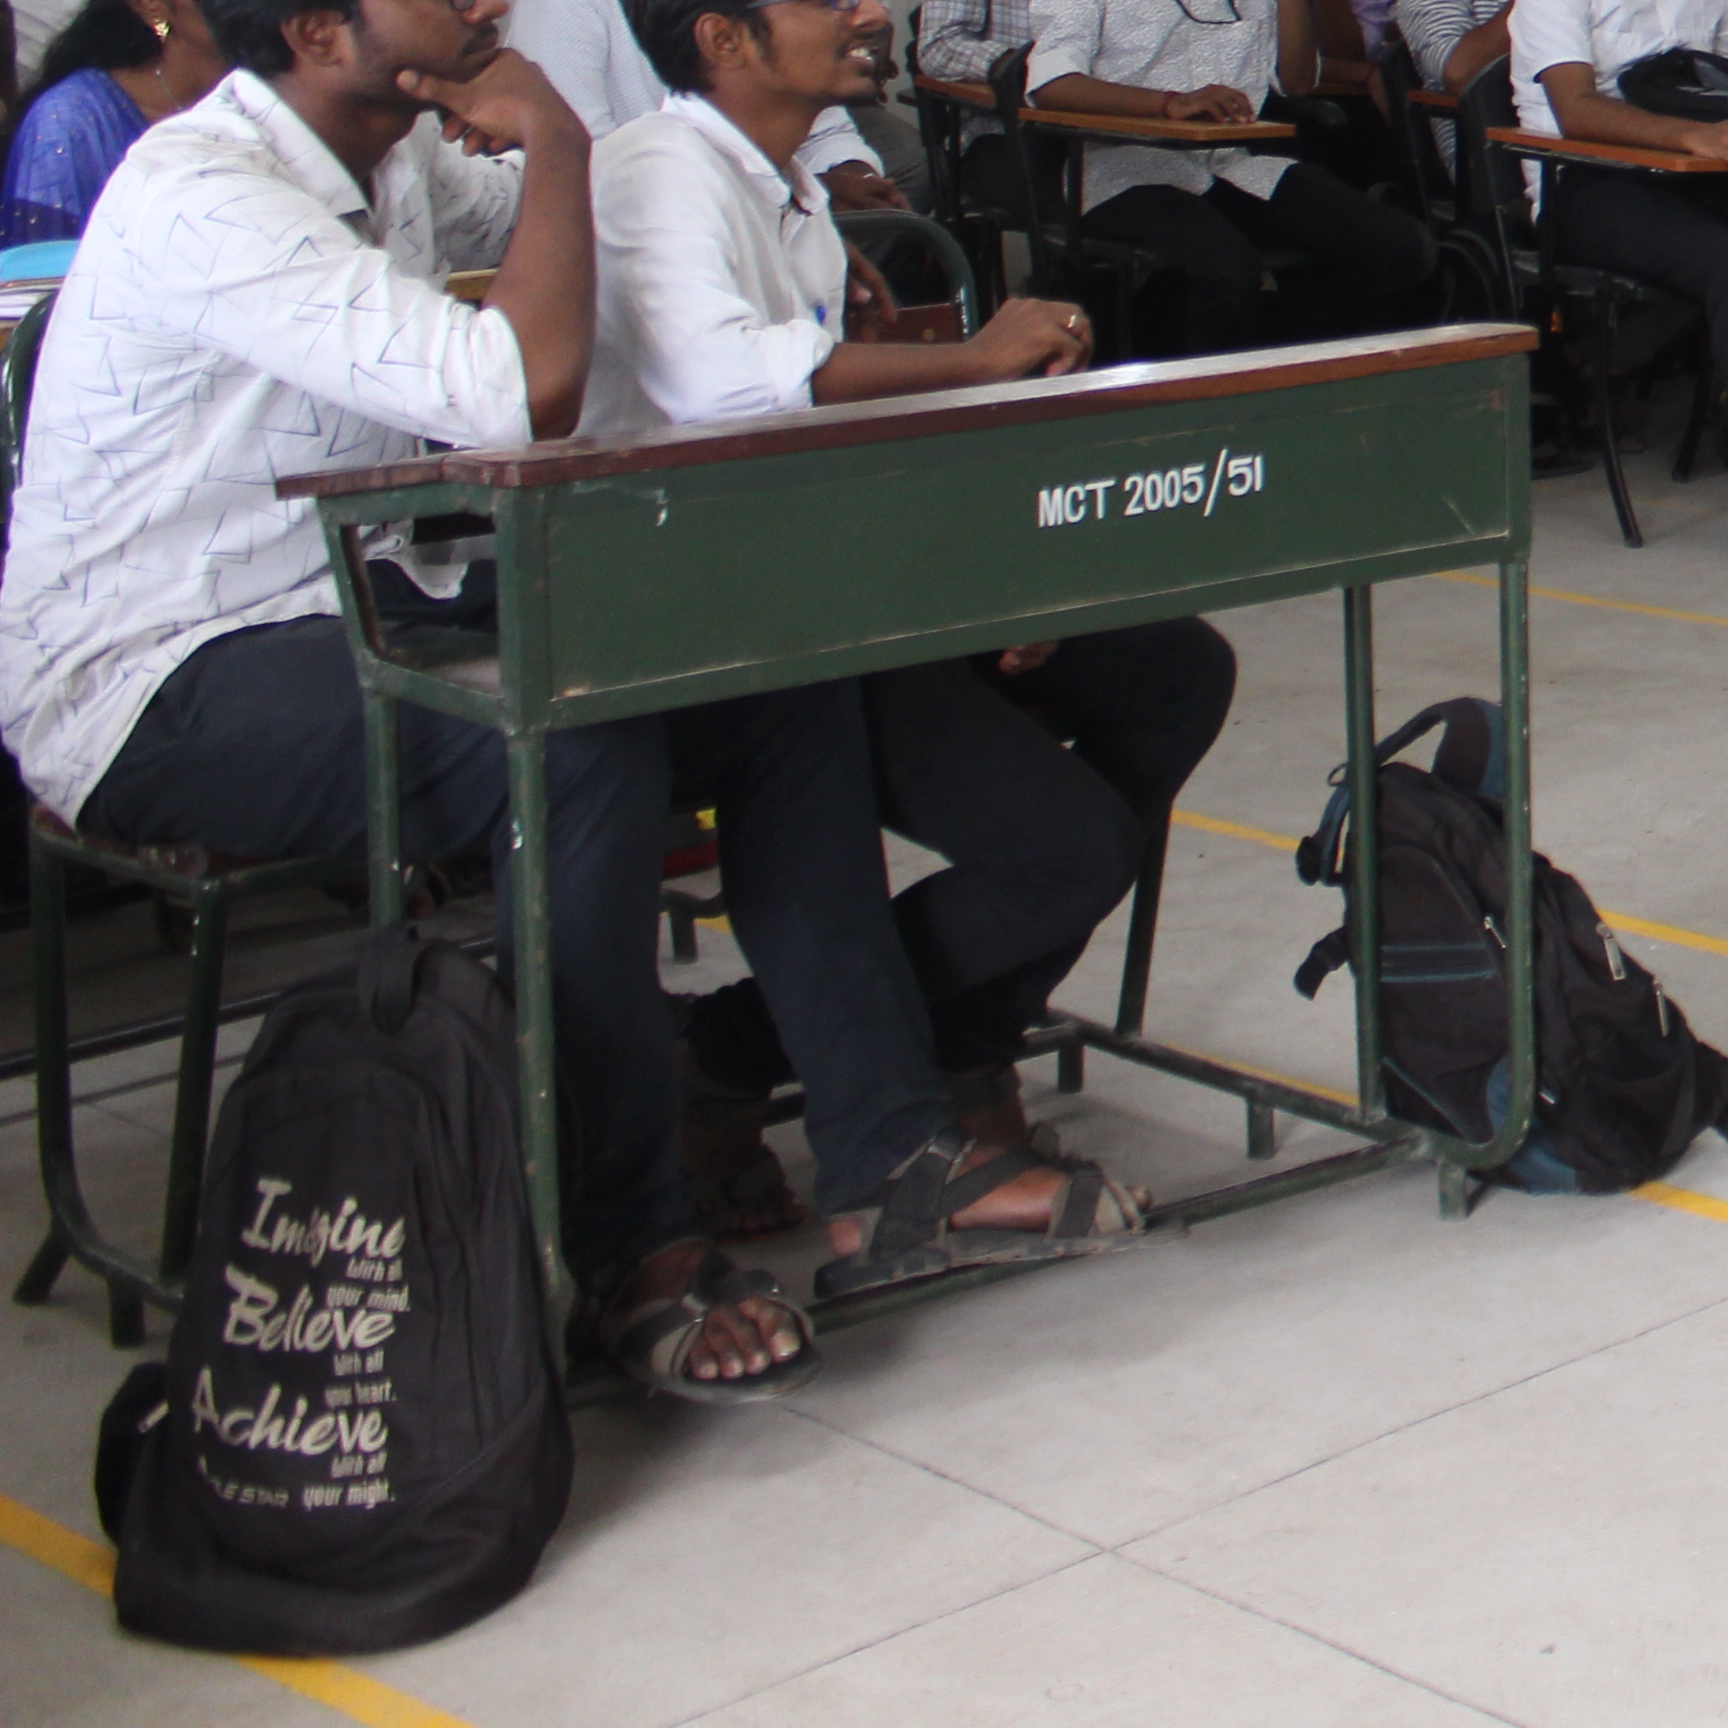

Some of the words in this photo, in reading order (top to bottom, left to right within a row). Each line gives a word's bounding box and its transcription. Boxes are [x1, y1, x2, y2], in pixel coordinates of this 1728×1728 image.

[1037, 478, 1116, 528] MCT
[1123, 446, 1264, 518] 2005/51
[223, 1262, 395, 1352] Believe
[192, 1364, 388, 1455] Achieve
[303, 1484, 343, 1511] your
